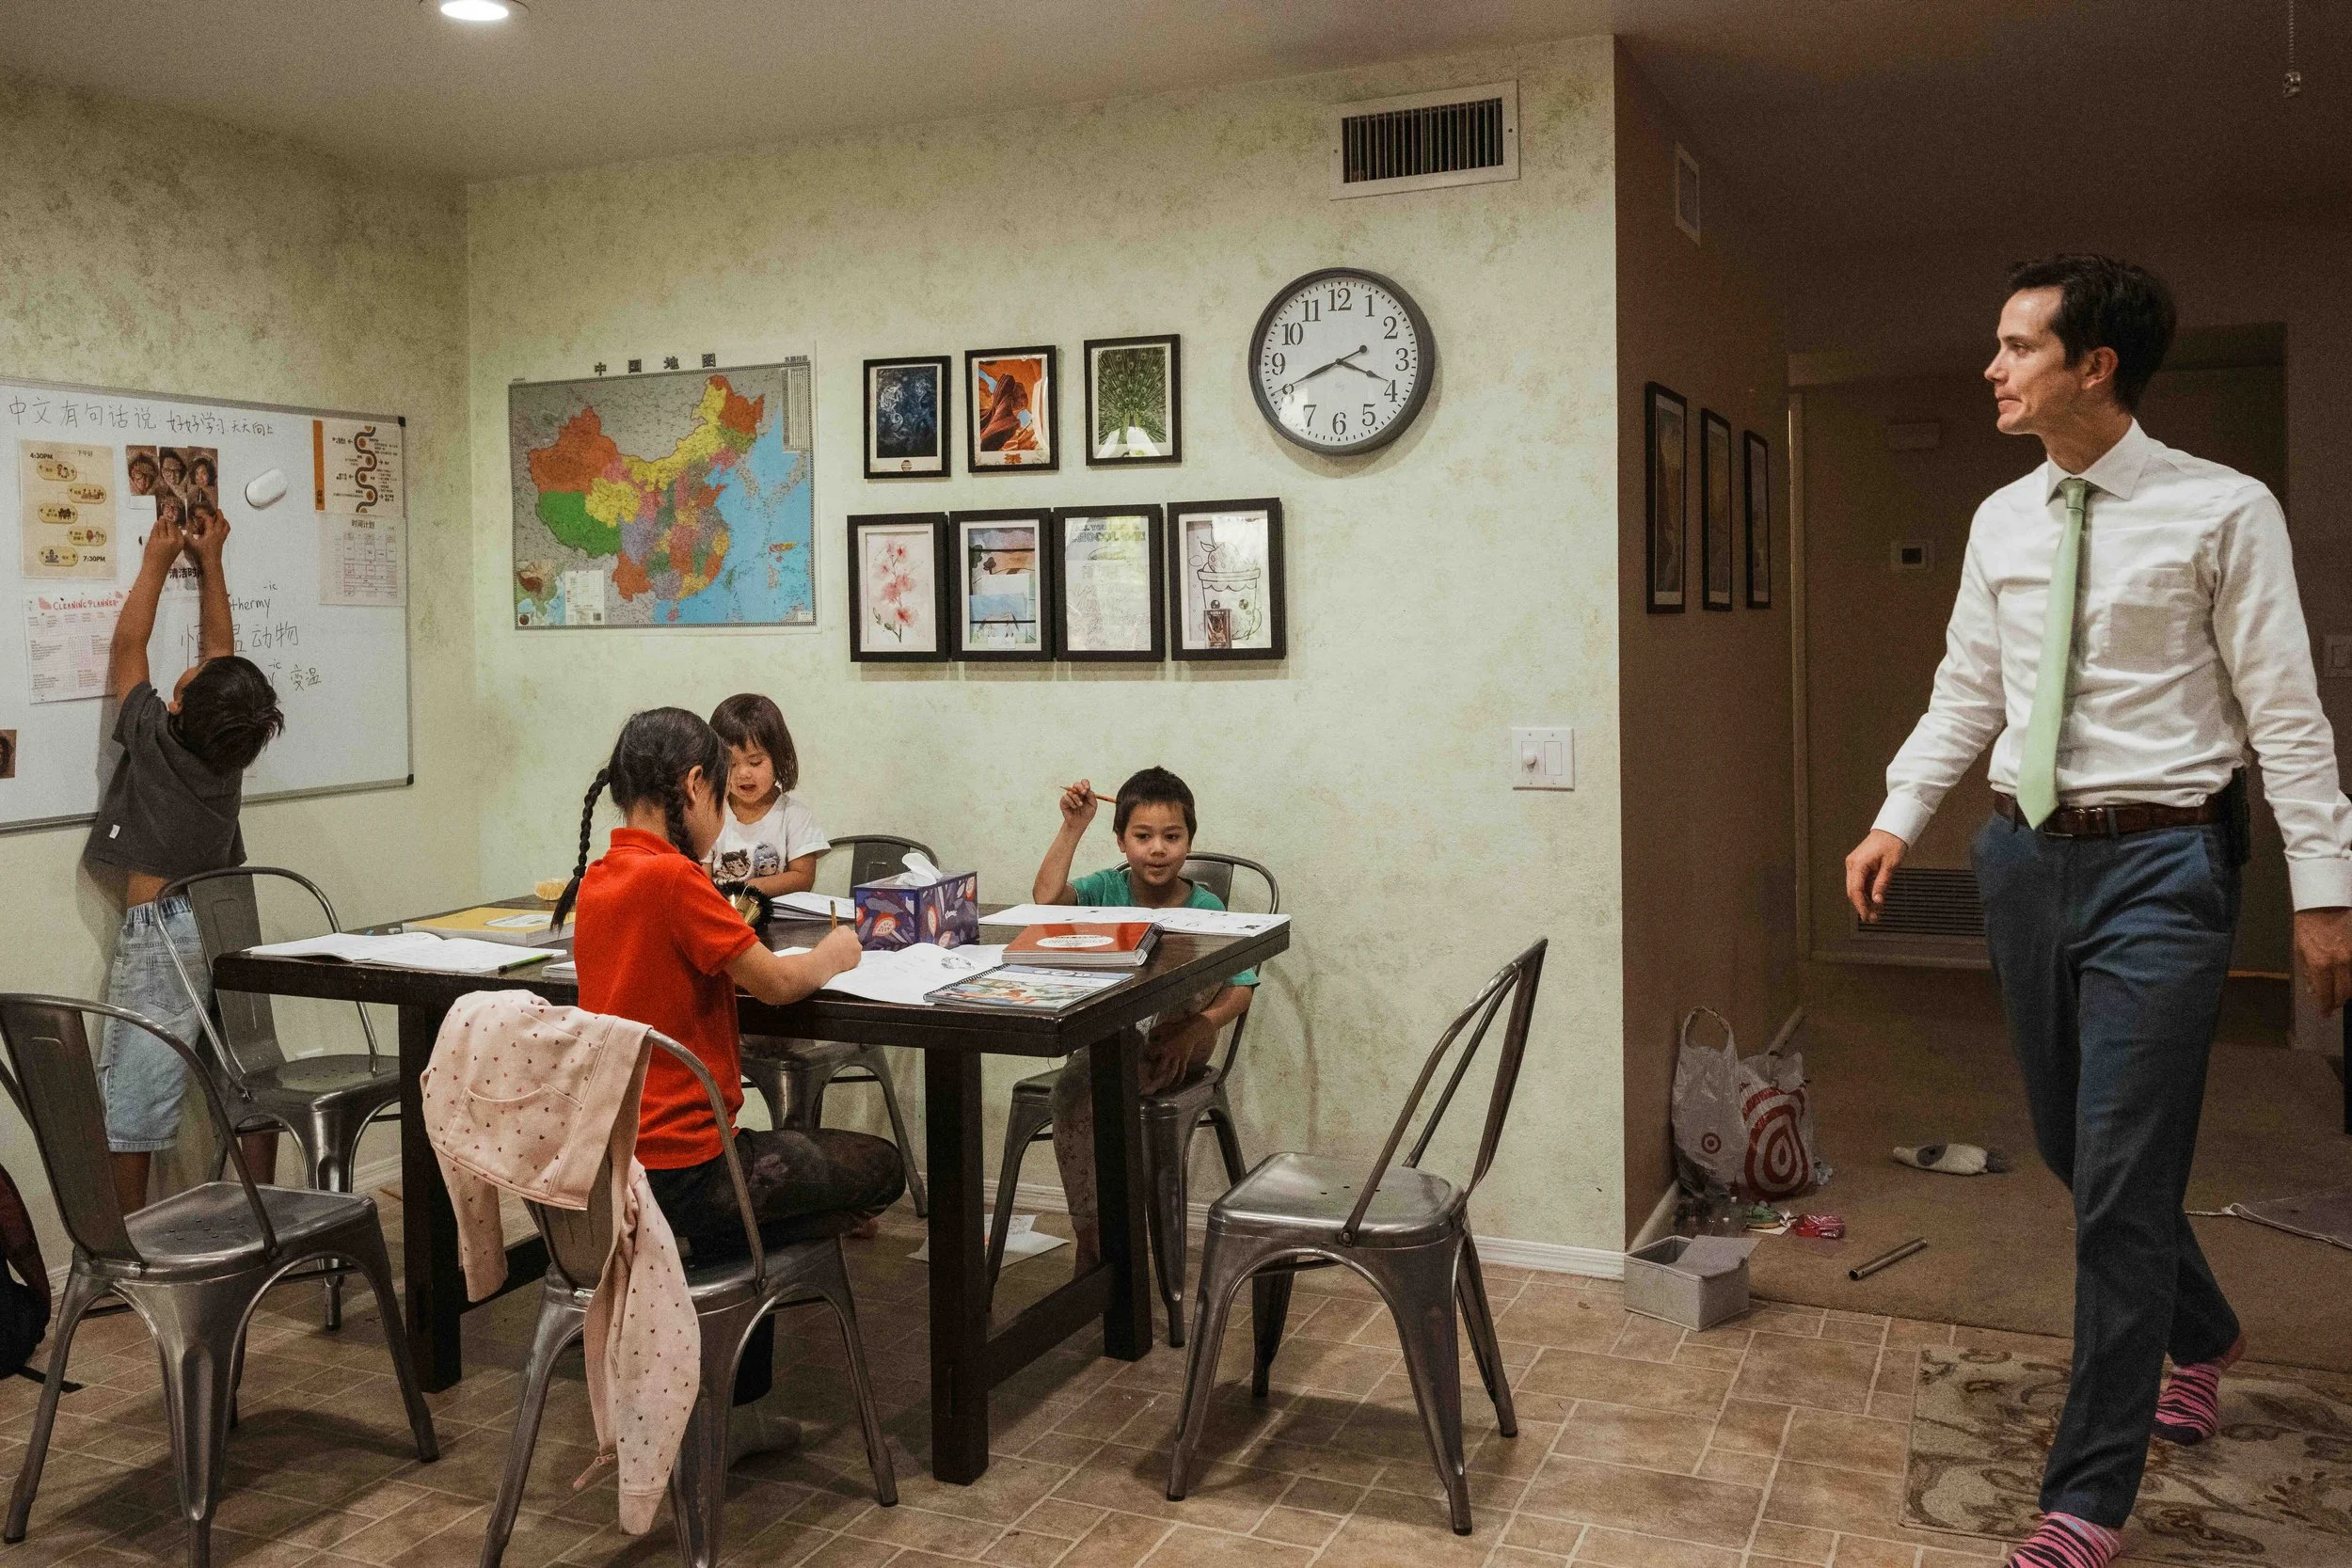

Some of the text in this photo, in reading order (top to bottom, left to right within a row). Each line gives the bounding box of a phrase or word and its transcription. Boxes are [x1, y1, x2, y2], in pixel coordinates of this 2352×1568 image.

[1302, 299, 1321, 323] 11
[1327, 288, 1353, 311] 12
[1365, 293, 1375, 317] 1
[1281, 322, 1304, 345] 10
[1383, 316, 1398, 340] 2
[594, 353, 717, 376] 中国地图
[1271, 352, 1286, 375] 9
[1395, 348, 1409, 372] 3
[1281, 384, 1295, 404] 8
[1383, 379, 1398, 403] 4
[1303, 404, 1317, 428] 7
[1332, 412, 1346, 436] 6
[1361, 403, 1376, 427] 5
